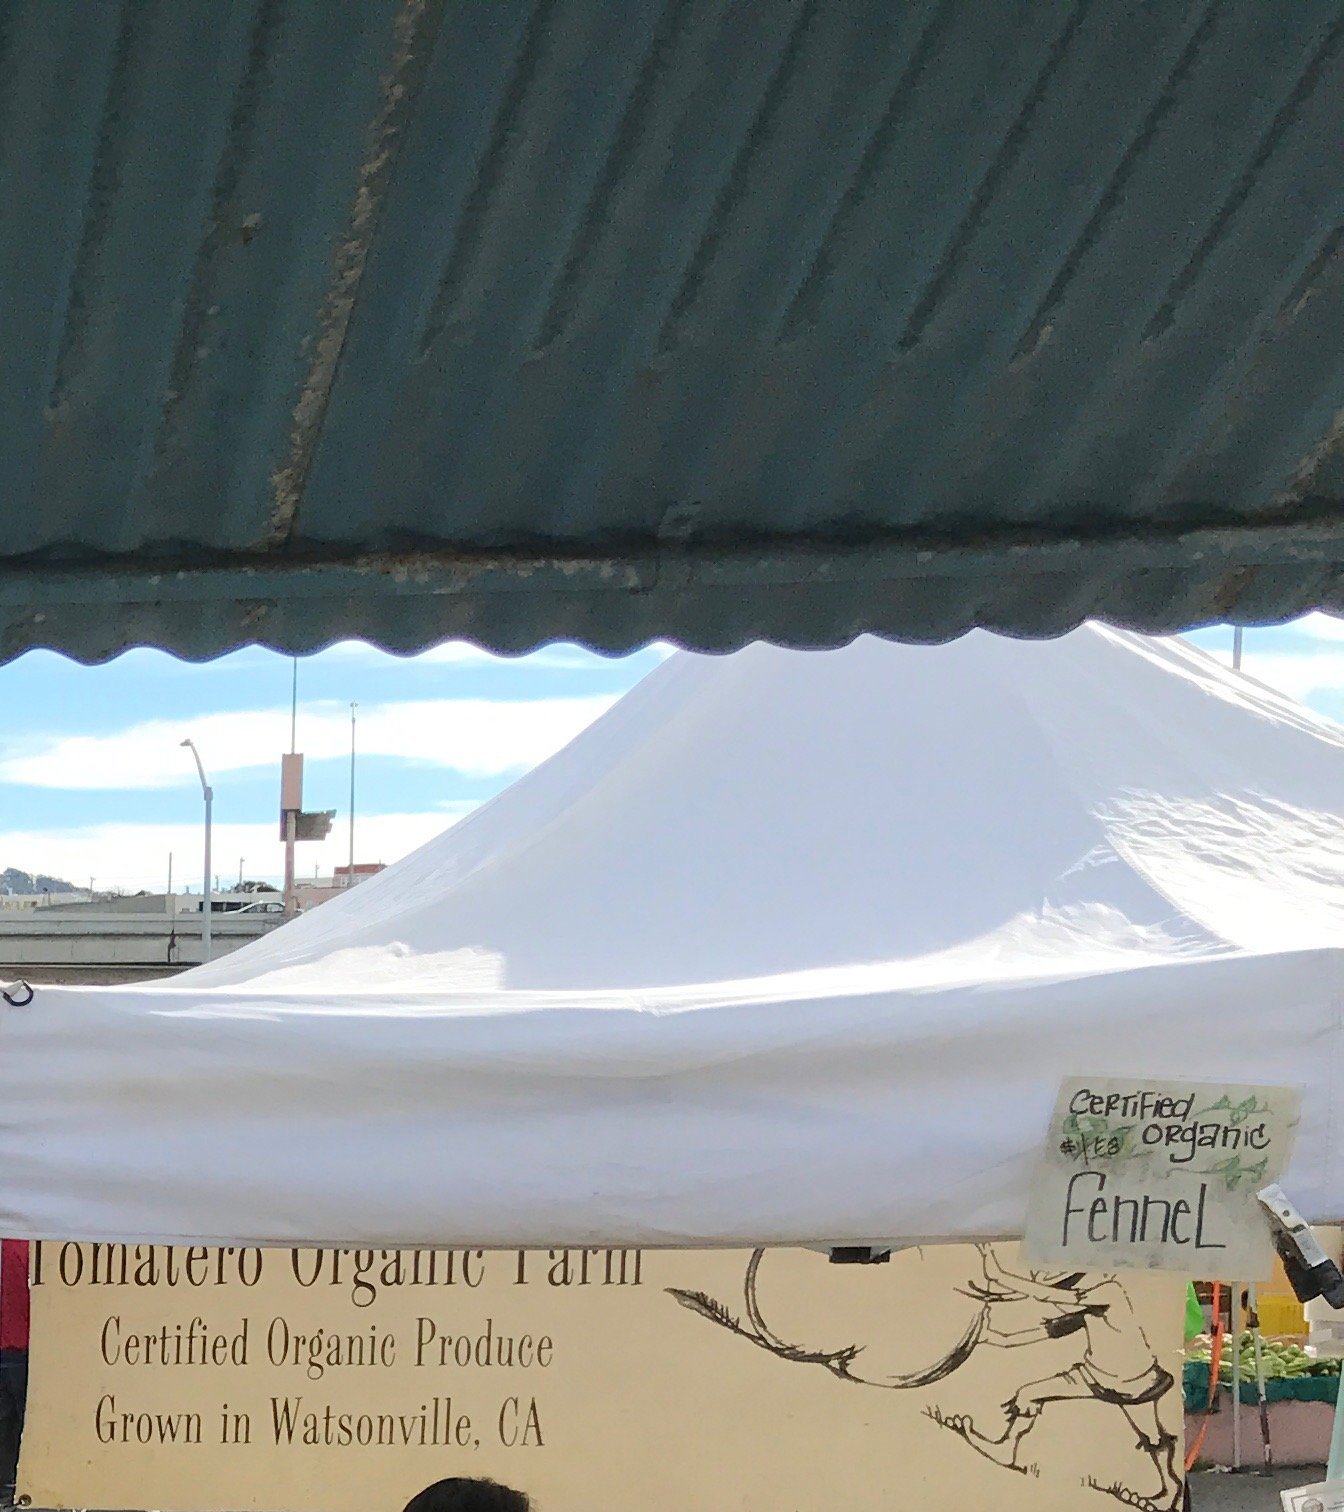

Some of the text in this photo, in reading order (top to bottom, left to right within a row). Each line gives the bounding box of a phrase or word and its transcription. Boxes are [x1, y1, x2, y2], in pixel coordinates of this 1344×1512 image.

[100, 1315, 554, 1380] Certified Organic Produce
[94, 1394, 545, 1452] Grown in Watsonville, CA
